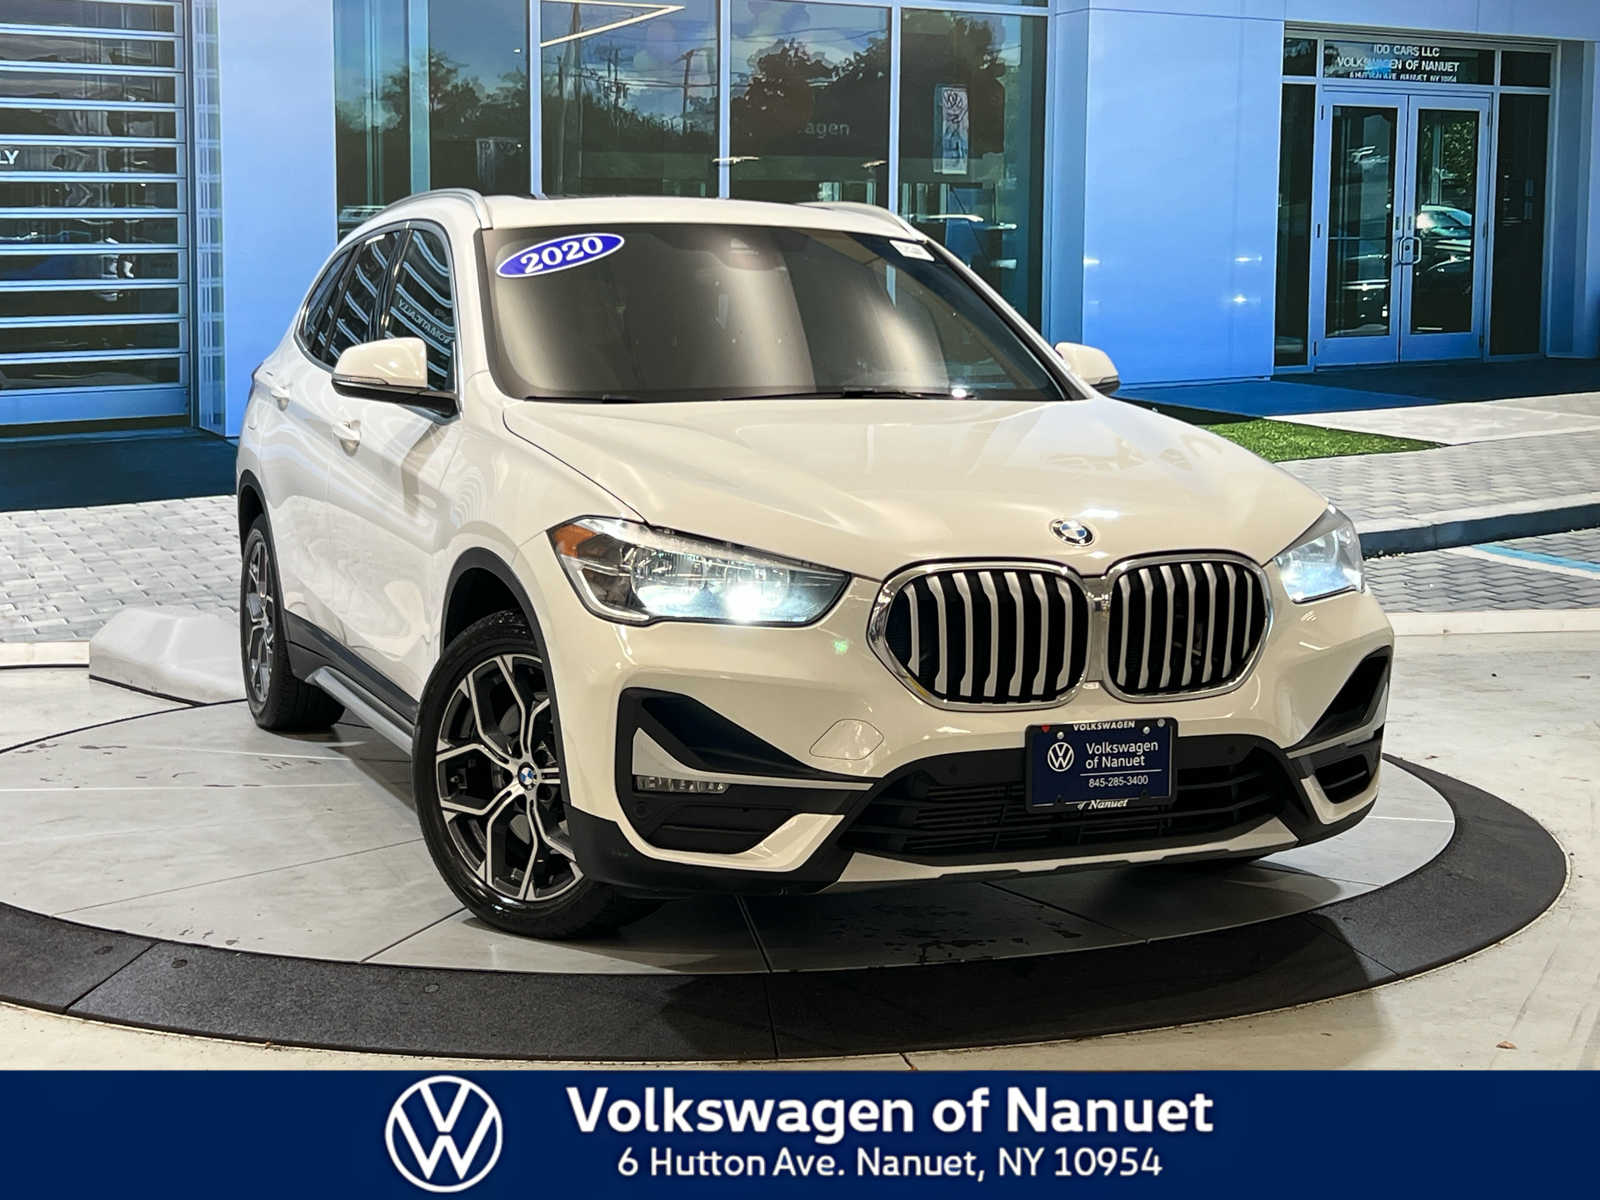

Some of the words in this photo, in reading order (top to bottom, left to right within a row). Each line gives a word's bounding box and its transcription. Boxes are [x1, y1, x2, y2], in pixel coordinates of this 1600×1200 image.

[1393, 45, 1419, 57] CARS
[1421, 46, 1440, 58] LLC
[1406, 59, 1419, 70] OF
[1421, 60, 1460, 72] NANUET
[520, 236, 604, 274] 2020
[1072, 720, 1136, 731] VOLKSWAGEN
[1085, 741, 1159, 756] Volkswagen
[1085, 756, 1099, 769] of
[1101, 755, 1145, 768] Nanuet
[1088, 775, 1149, 788] 845-285-3400
[1087, 799, 1129, 810] Nanuet
